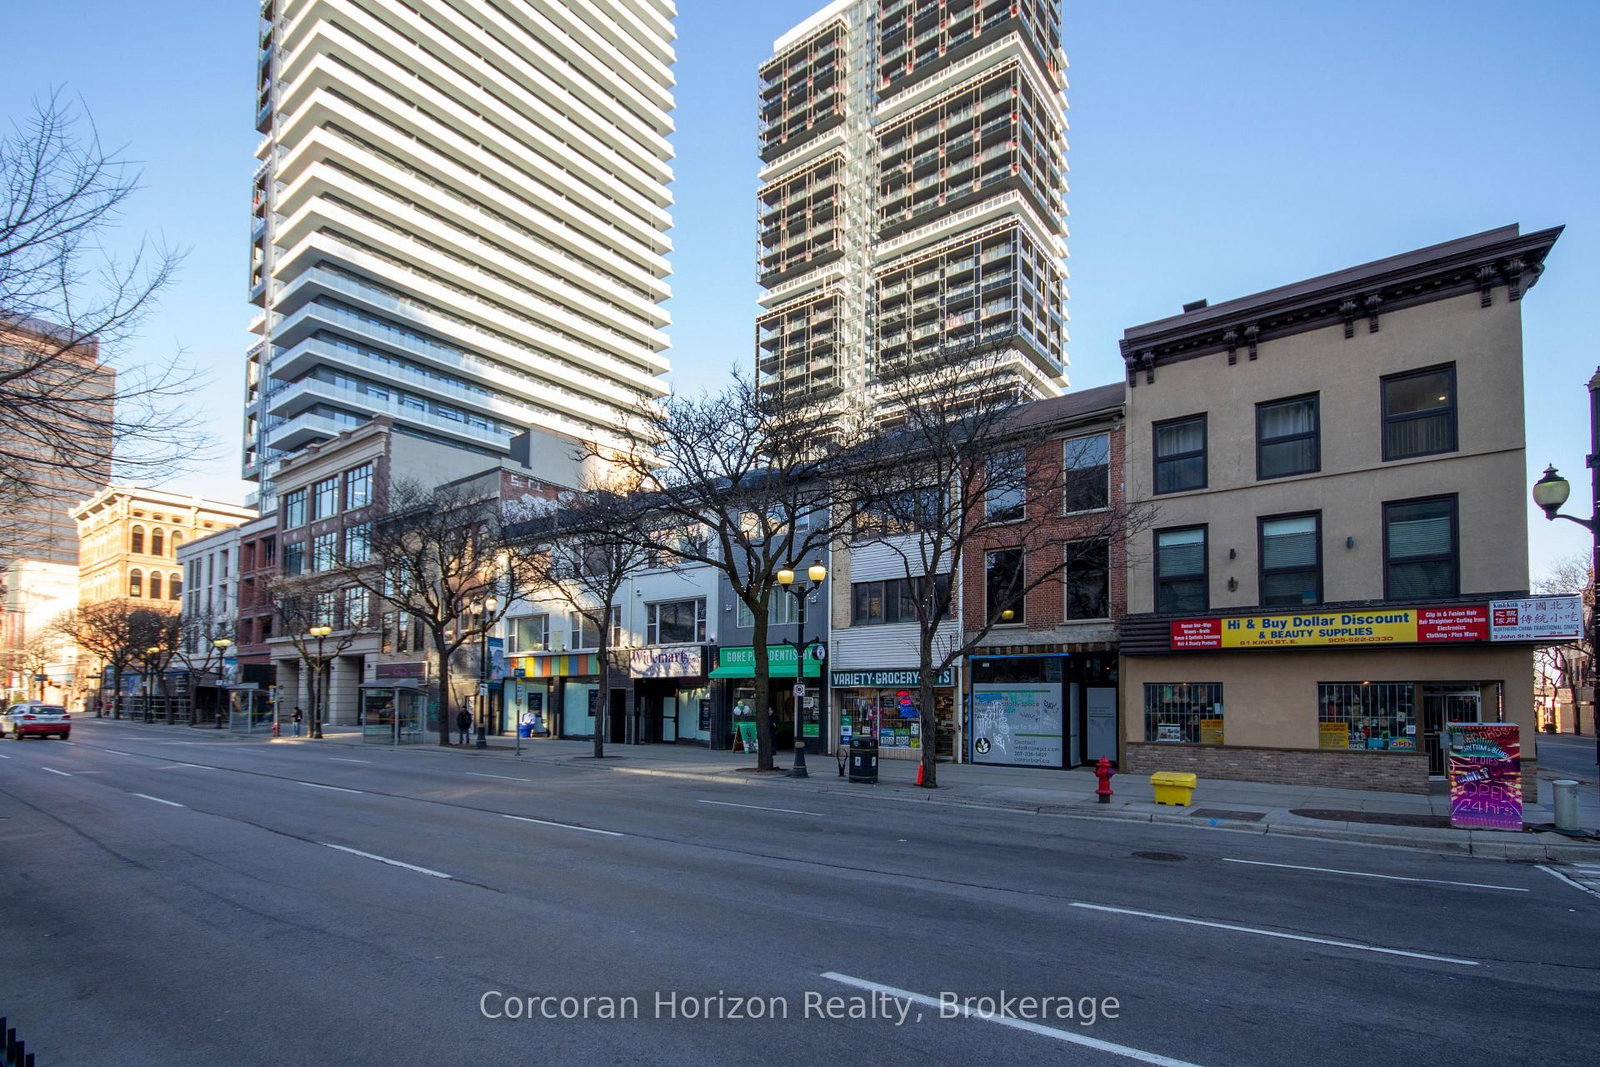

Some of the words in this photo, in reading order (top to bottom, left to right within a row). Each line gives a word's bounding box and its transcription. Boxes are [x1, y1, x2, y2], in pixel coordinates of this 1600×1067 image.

[1521, 600, 1578, 612] 中國北方
[1228, 620, 1240, 629] Hi
[1246, 619, 1255, 629] &
[1262, 618, 1287, 629] Buy
[1293, 616, 1335, 627] Dollar
[1341, 613, 1409, 625] Discount
[1520, 612, 1579, 624] 傳統小吃
[1271, 629, 1313, 638] BEAUTY
[1318, 627, 1373, 637] SUPPLIES
[727, 651, 746, 662] GORE
[769, 649, 813, 661] DENTISRY
[833, 673, 872, 685] VARIETY
[876, 671, 920, 684] GROCERY
[1468, 755, 1499, 765] OLDIES
[1462, 782, 1513, 801] OPEN
